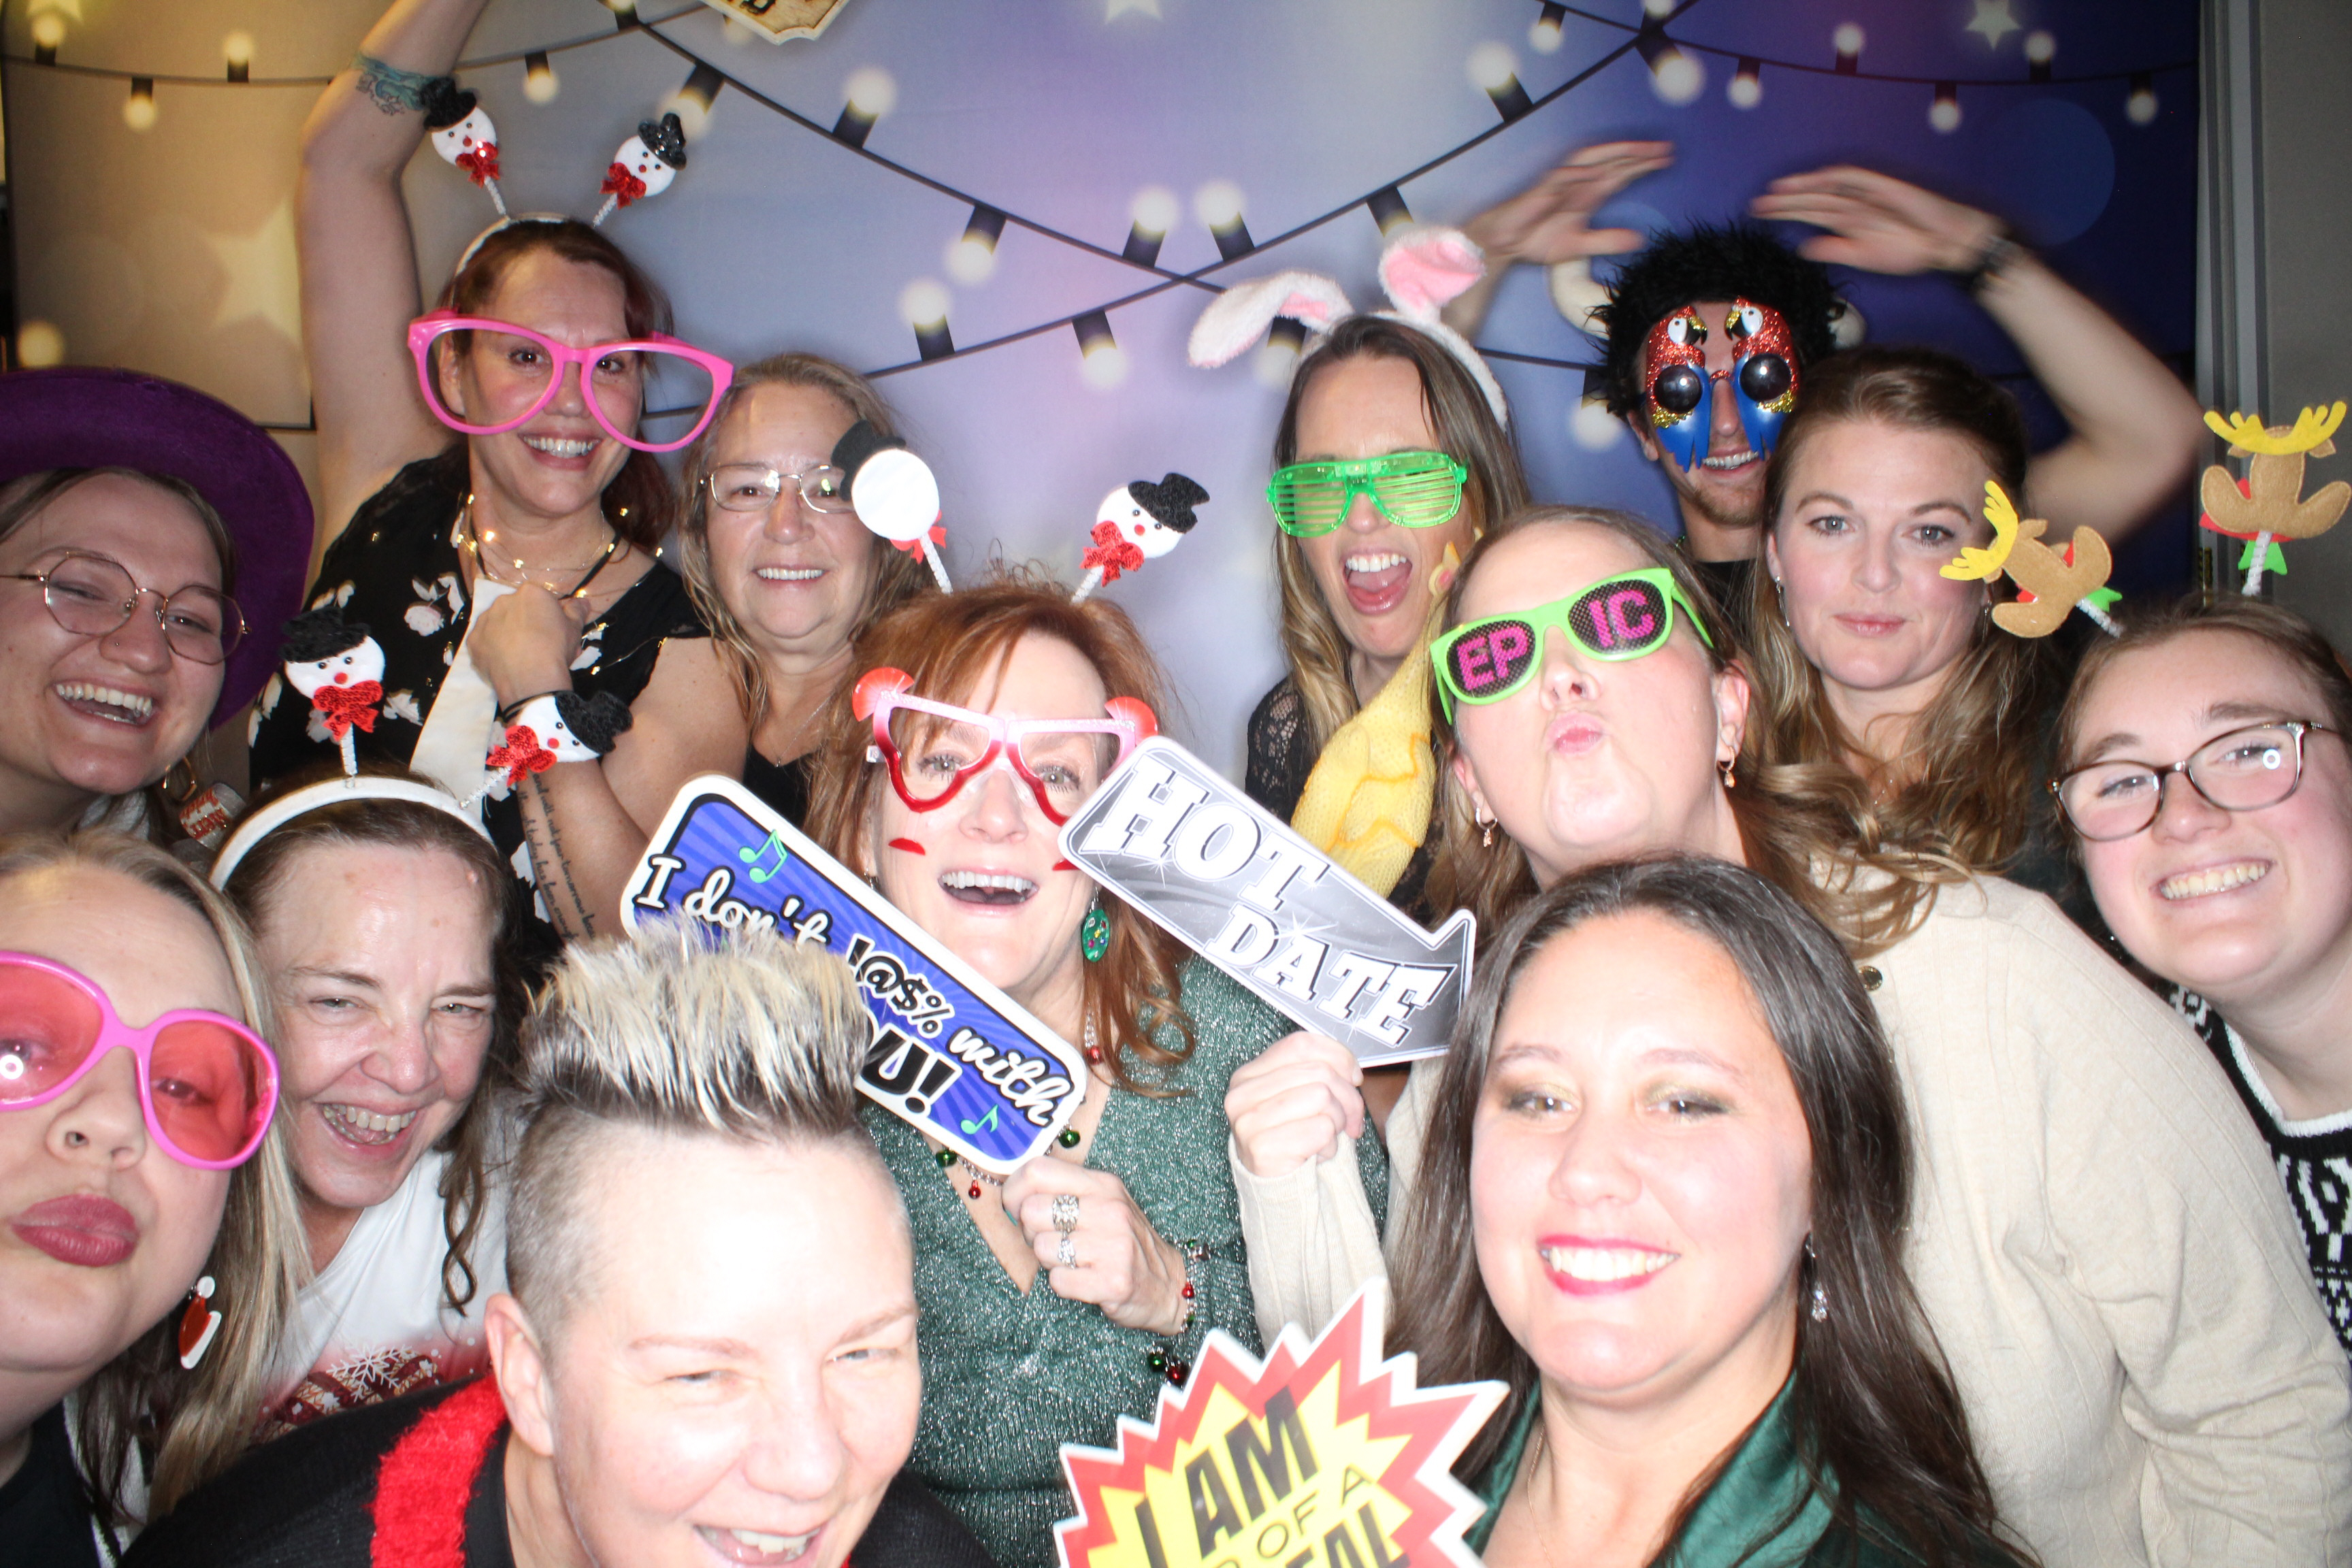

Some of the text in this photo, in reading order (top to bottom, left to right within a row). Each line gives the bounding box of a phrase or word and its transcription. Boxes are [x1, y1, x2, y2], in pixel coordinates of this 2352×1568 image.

[1456, 589, 1656, 691] EP IC
[1079, 753, 1330, 914] HOT
[634, 854, 685, 911] I
[683, 867, 832, 947] don't
[945, 1026, 1075, 1128] with
[1203, 902, 1458, 1047] DATE
[861, 1014, 956, 1113] U!
[1134, 1384, 1319, 1568] I AM
[1257, 1464, 1372, 1558] OF A
